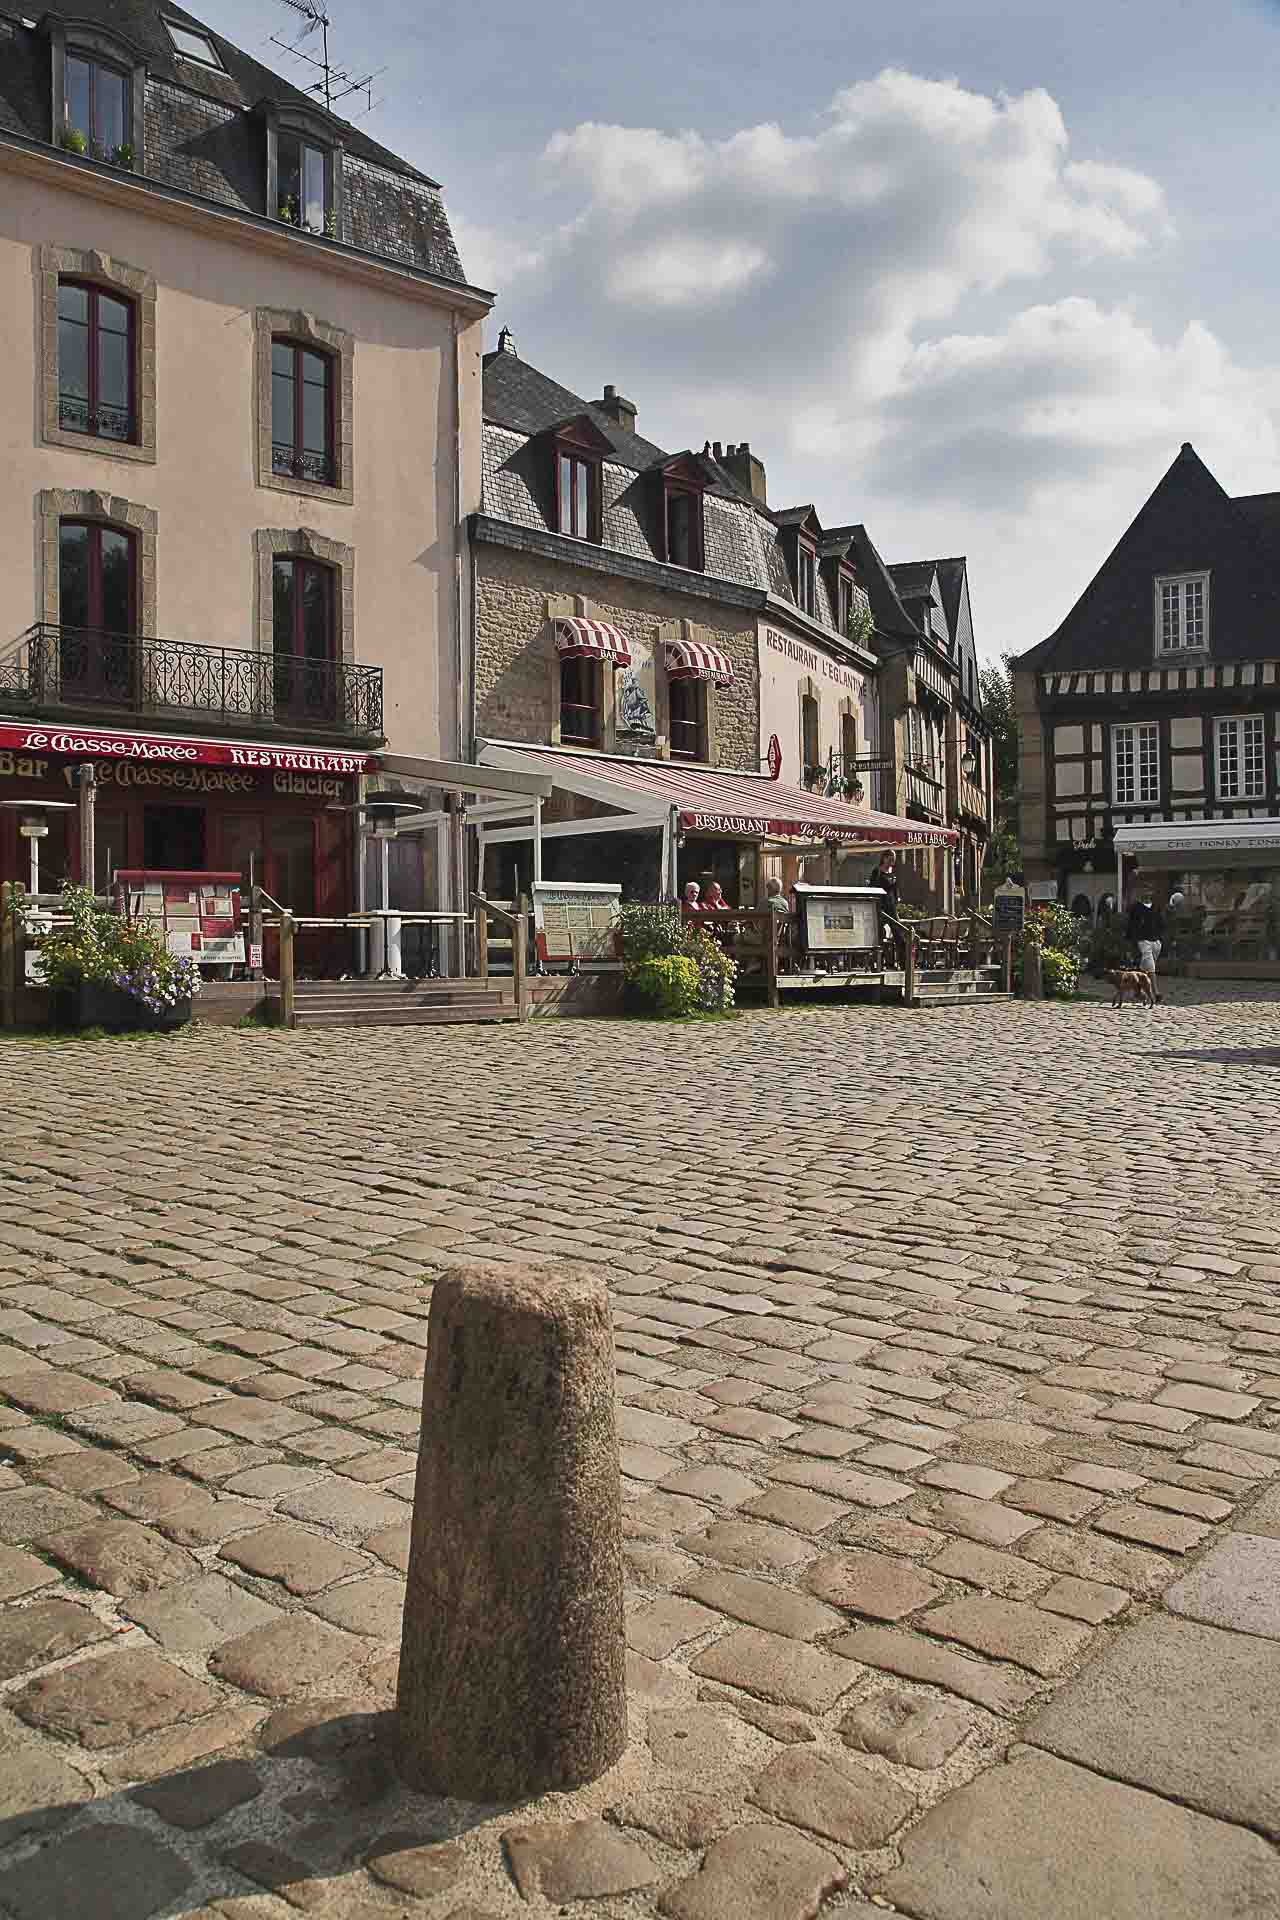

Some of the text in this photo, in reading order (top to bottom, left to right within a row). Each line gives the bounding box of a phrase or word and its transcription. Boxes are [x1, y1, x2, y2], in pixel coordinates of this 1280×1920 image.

[600, 649, 618, 661] BAR
[766, 628, 818, 672] RESTAURANT
[23, 733, 48, 749] Le
[0, 752, 48, 777] Bar
[230, 749, 367, 773] RESTAURANT
[849, 760, 893, 770] Restaurant
[273, 770, 344, 797] Glacier
[695, 813, 948, 846] RESTAURANT La Licorne BAR TABAC
